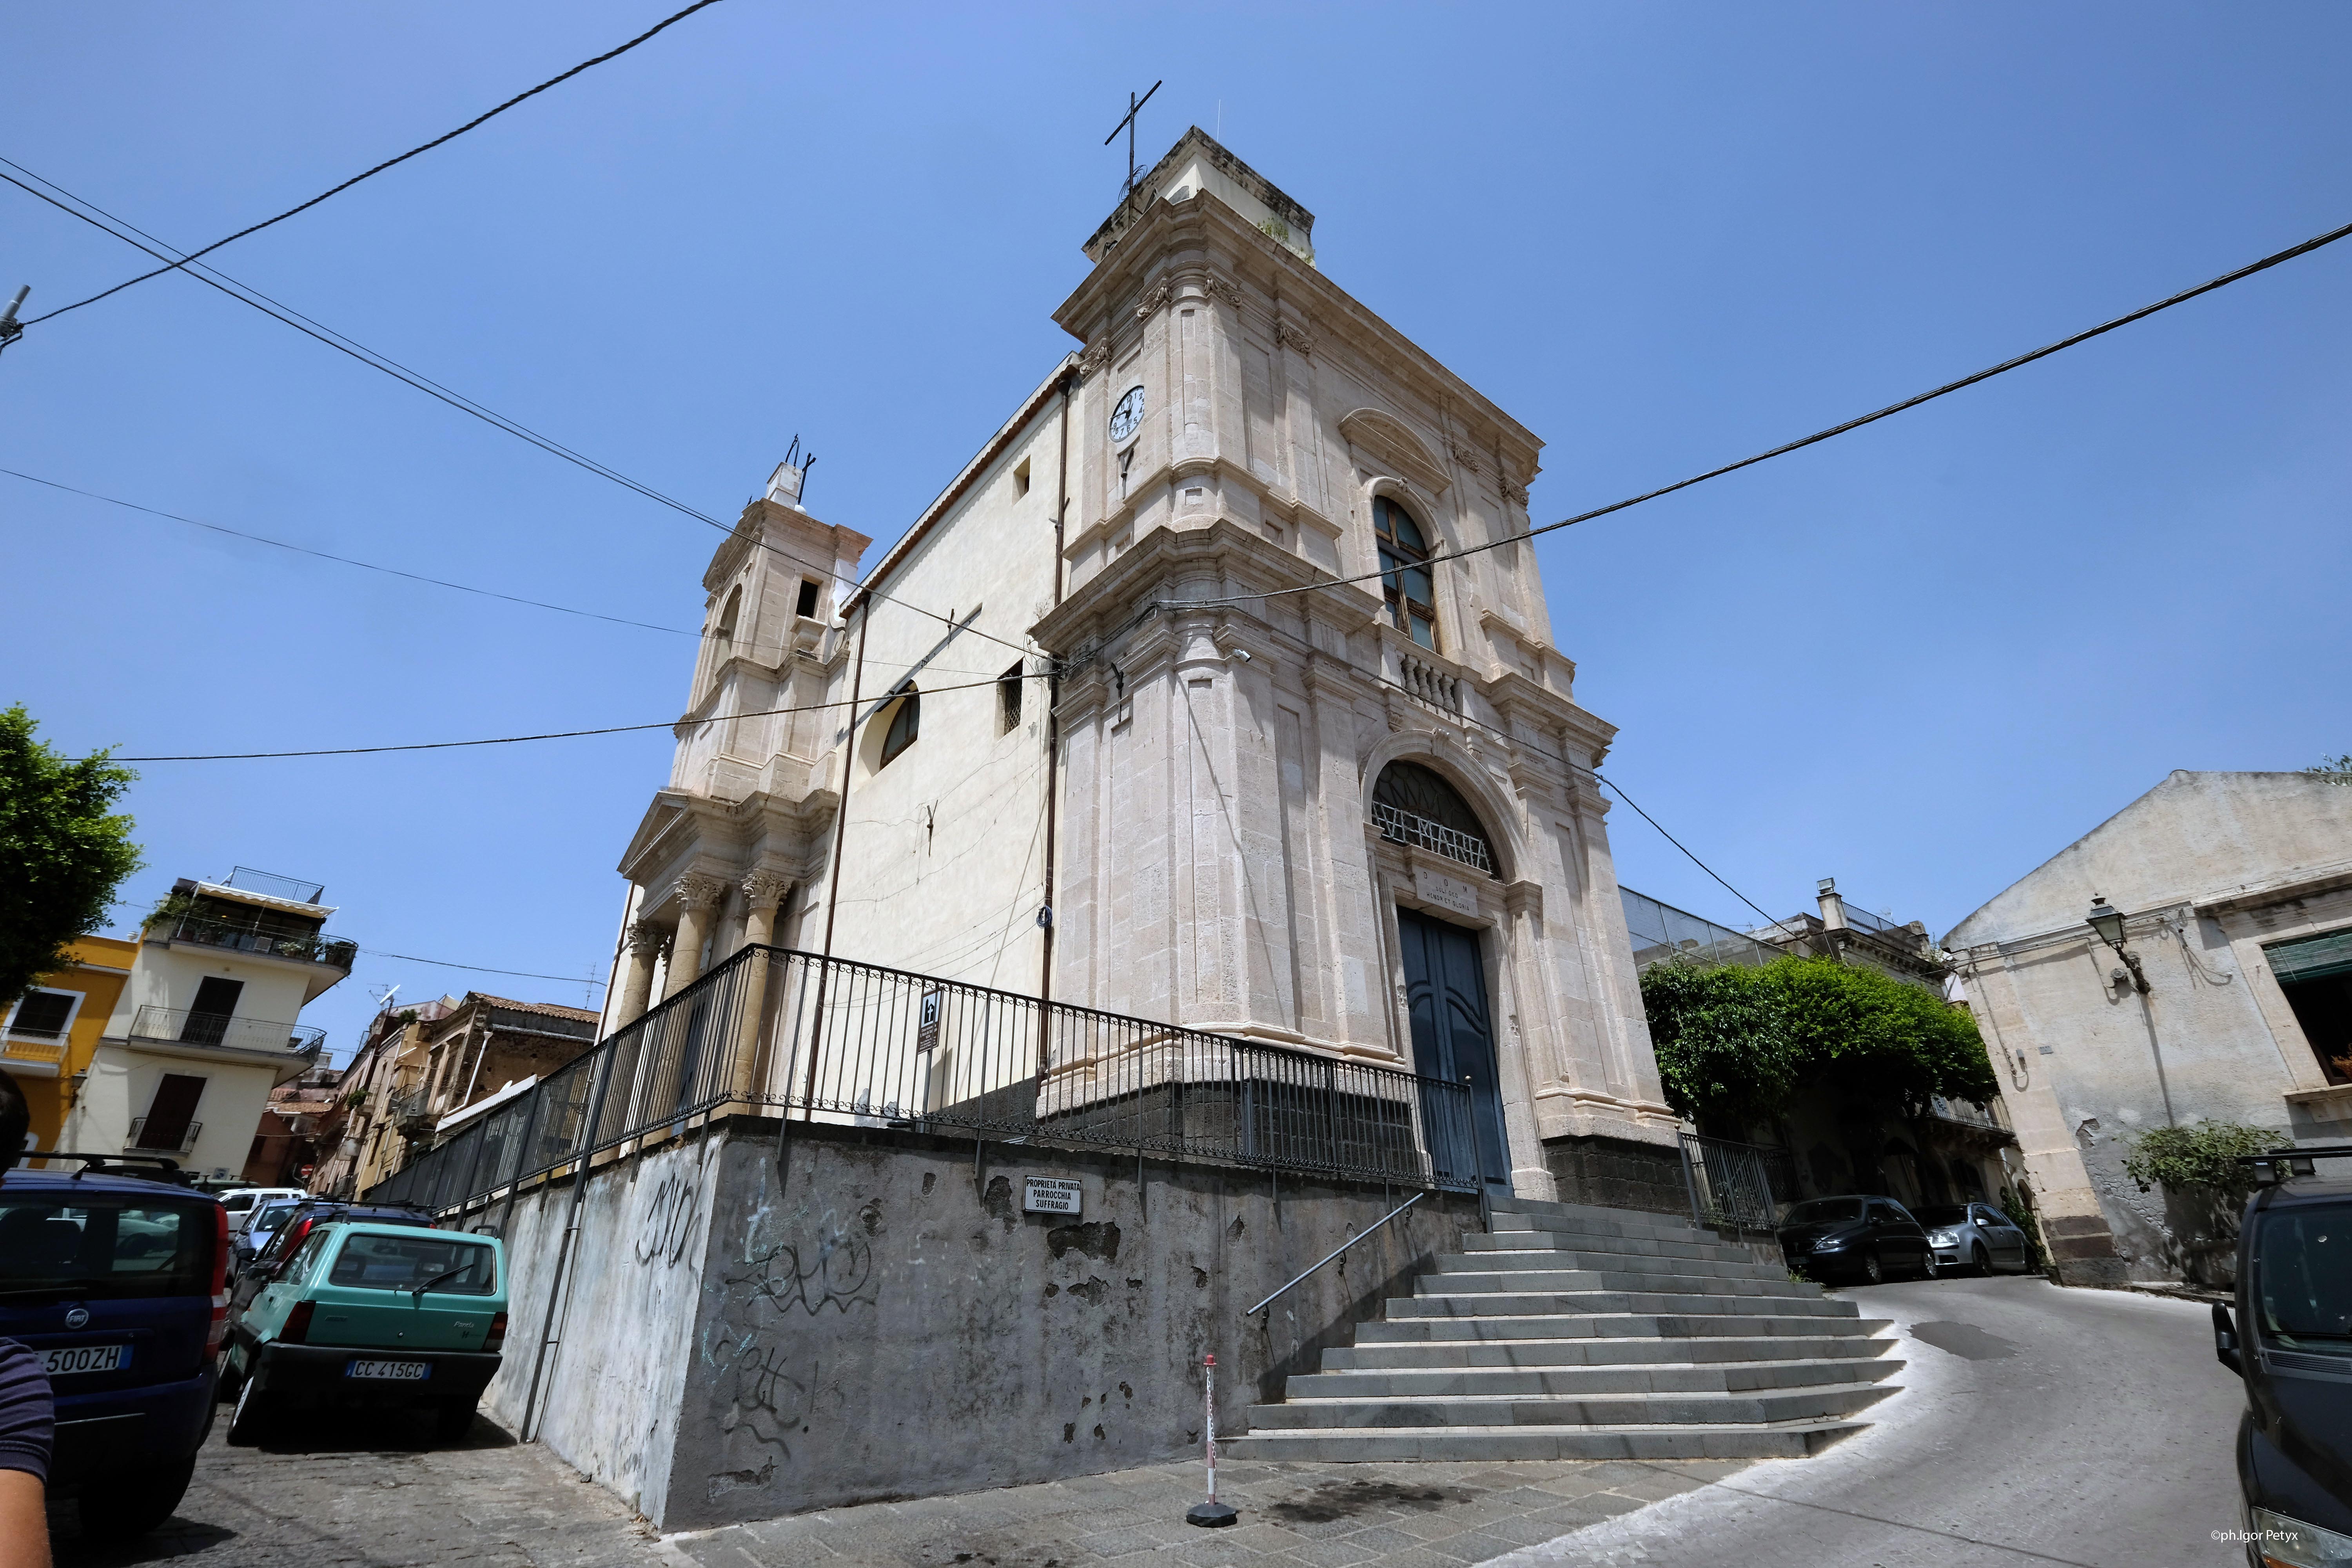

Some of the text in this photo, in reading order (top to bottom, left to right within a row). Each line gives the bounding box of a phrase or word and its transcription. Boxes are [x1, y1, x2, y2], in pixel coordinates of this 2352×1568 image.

[1453, 901, 1470, 911] GLORIA
[1026, 1179, 1080, 1191] PROPRIETÀ PRIVATA
[1033, 1189, 1071, 1200] PARROCCHIA
[1036, 1200, 1069, 1210] SUFFRAGIO
[46, 1347, 120, 1372] 500ZH
[355, 1362, 425, 1378] CC 415GC
